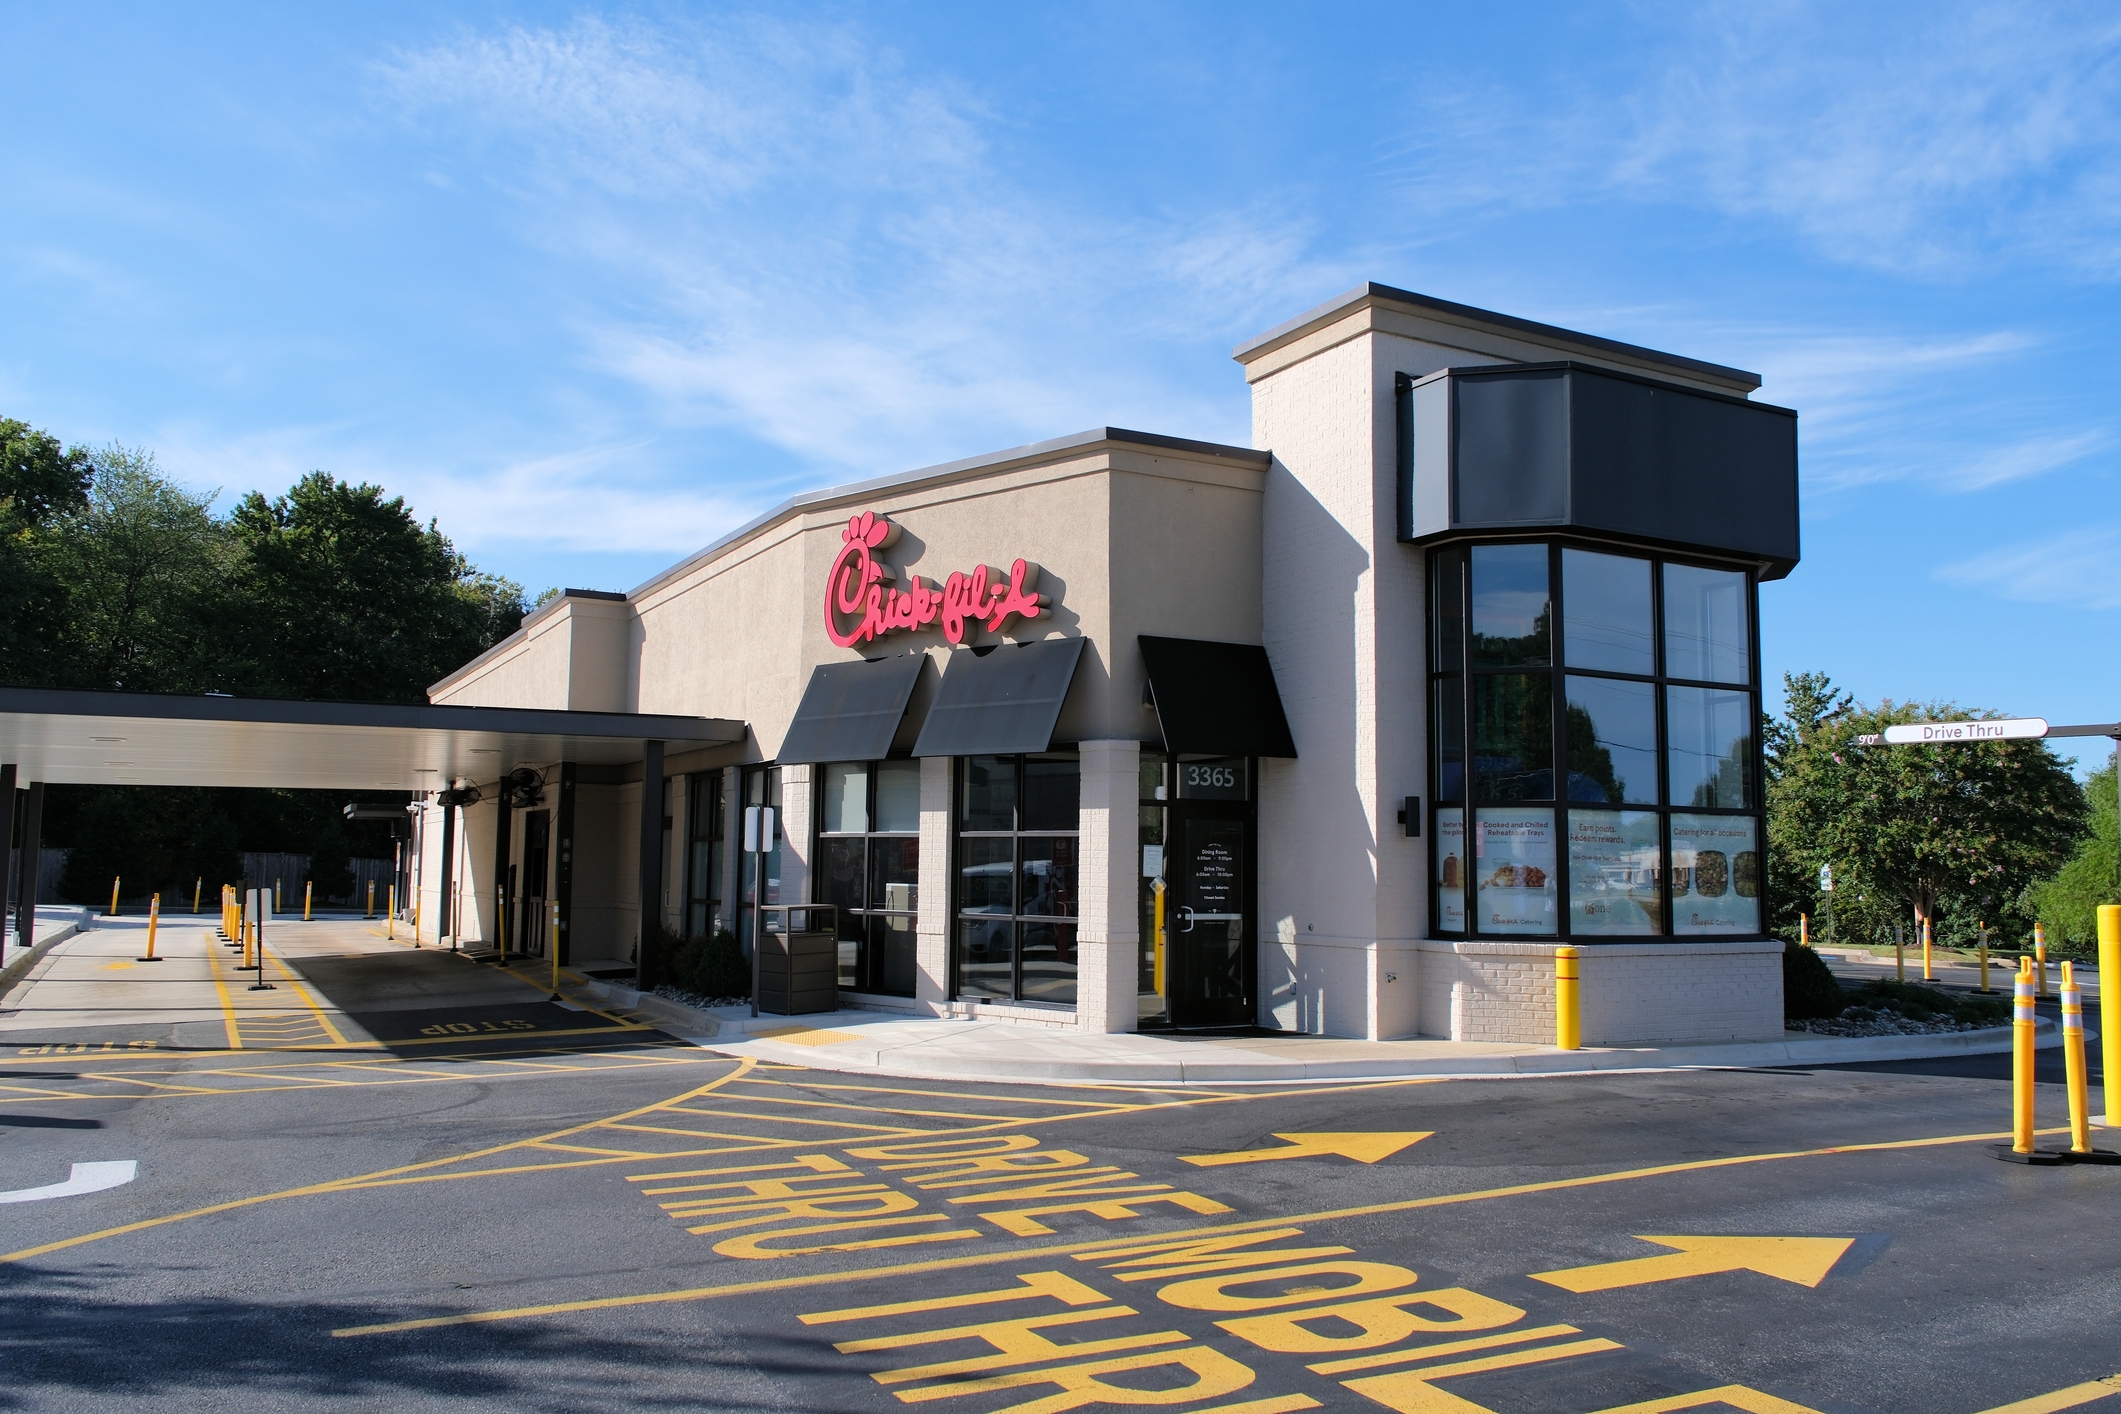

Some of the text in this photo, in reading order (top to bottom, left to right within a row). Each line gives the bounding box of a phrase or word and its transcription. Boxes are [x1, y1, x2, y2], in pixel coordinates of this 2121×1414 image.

[824, 510, 1041, 648] Chick-fil-A
[1923, 724, 2004, 740] Drive Thru
[1188, 765, 1235, 788] 3365
[1527, 829, 1545, 837] Trays
[1579, 823, 1617, 834] Earn points.
[1673, 827, 1699, 838] Catering
[1700, 828, 1709, 836] for
[1718, 829, 1747, 837] occasions
[1570, 833, 1626, 844] Redeem rewards.
[1594, 904, 1611, 913] one
[420, 1019, 536, 1035] STOP
[18, 1039, 160, 1055] STOP
[843, 1134, 1236, 1238] DRIVE
[625, 1154, 983, 1261] THRU
[1070, 1228, 1826, 1414] MOBIL
[797, 1270, 1326, 1414] THR
